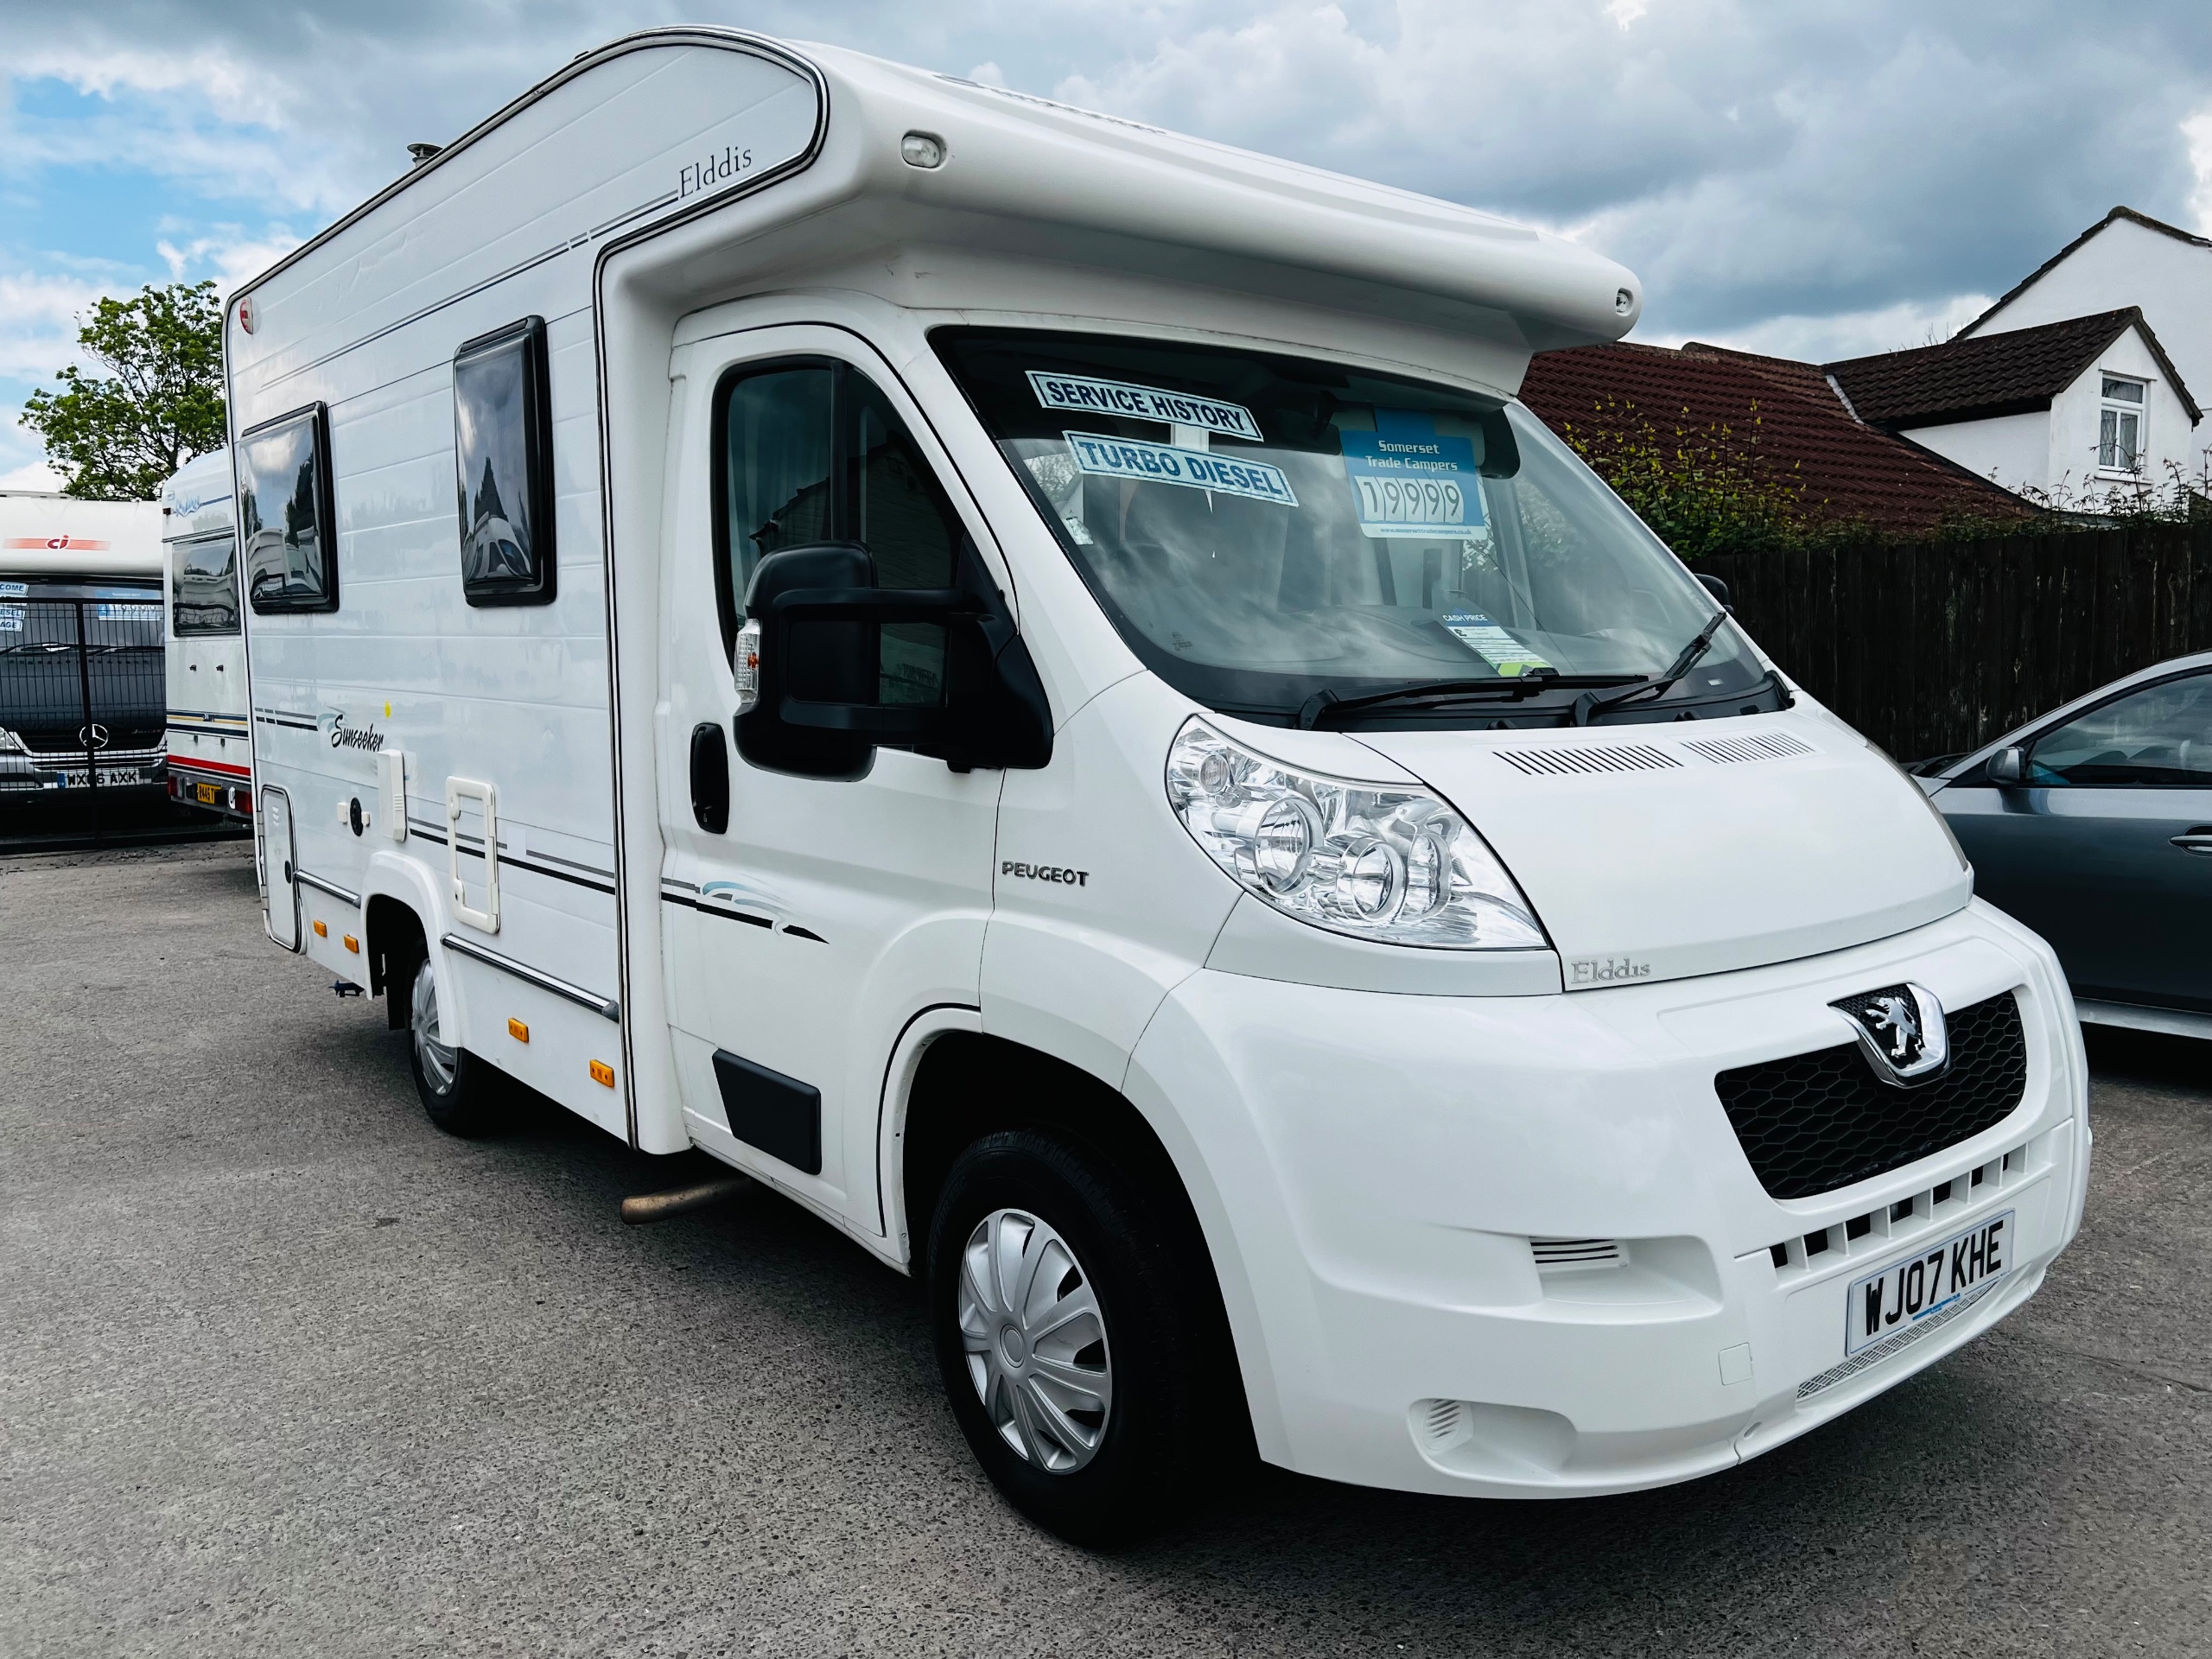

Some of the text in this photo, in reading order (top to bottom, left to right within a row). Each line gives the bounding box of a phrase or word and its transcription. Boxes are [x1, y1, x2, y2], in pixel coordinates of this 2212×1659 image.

[679, 146, 752, 199] Elddis
[1046, 381, 1245, 430] SERVICE HISTORY
[1365, 455, 1458, 473] Trade Campers
[1378, 440, 1440, 454] Somerset
[1079, 442, 1283, 495] TURBO DIESEL
[1363, 481, 1460, 517] 19999
[331, 714, 384, 753] Sunseeker
[67, 772, 137, 785] WX6 AXK
[1002, 861, 1090, 887] PEUGEOT
[1571, 957, 1651, 984] Elddis
[1866, 1219, 2004, 1337] WJ07 KHE
